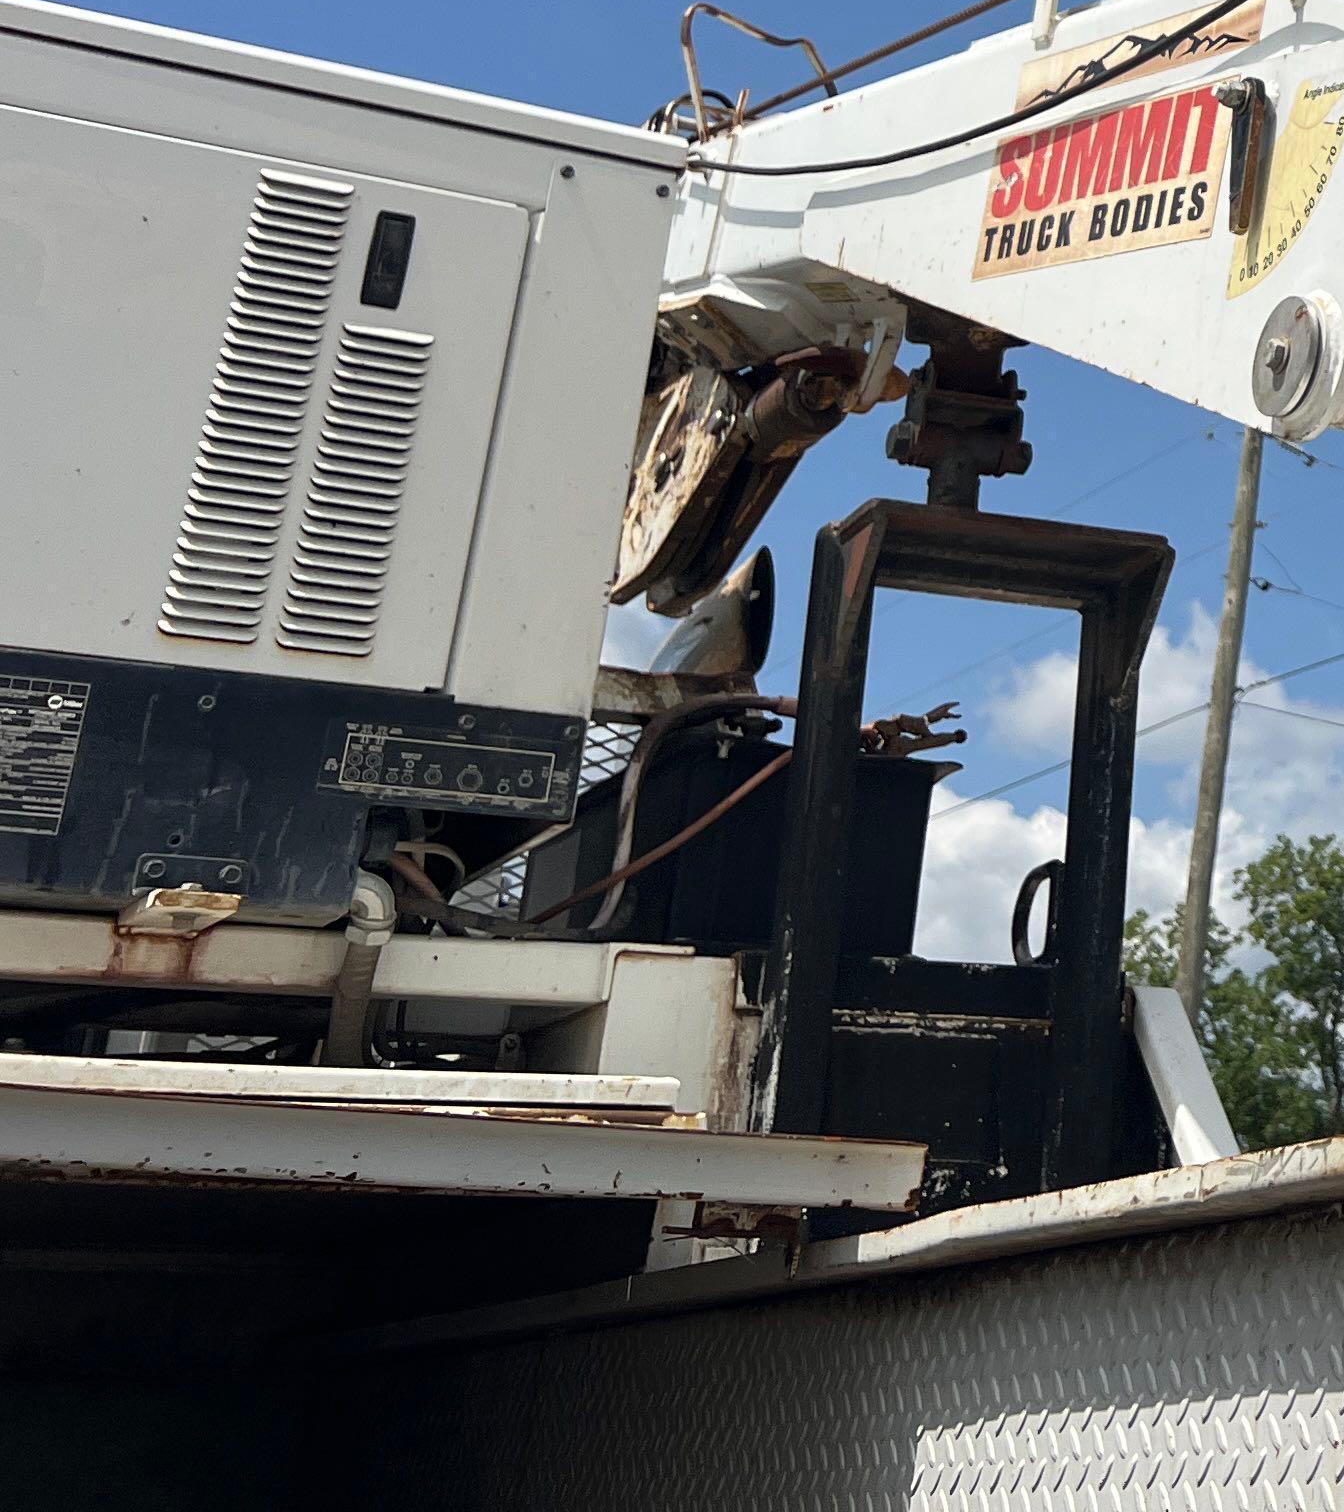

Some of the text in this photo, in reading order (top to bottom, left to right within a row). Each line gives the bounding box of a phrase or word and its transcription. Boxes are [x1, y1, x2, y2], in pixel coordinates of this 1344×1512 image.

[991, 85, 1220, 219] SUMMIT
[1263, 251, 1273, 270] 20
[1277, 238, 1287, 257] 30
[1291, 219, 1301, 238] 40
[1304, 197, 1315, 217] 50
[1316, 173, 1327, 193] 60
[1326, 146, 1337, 165] 70
[983, 181, 1208, 263] TRUCK BODIES
